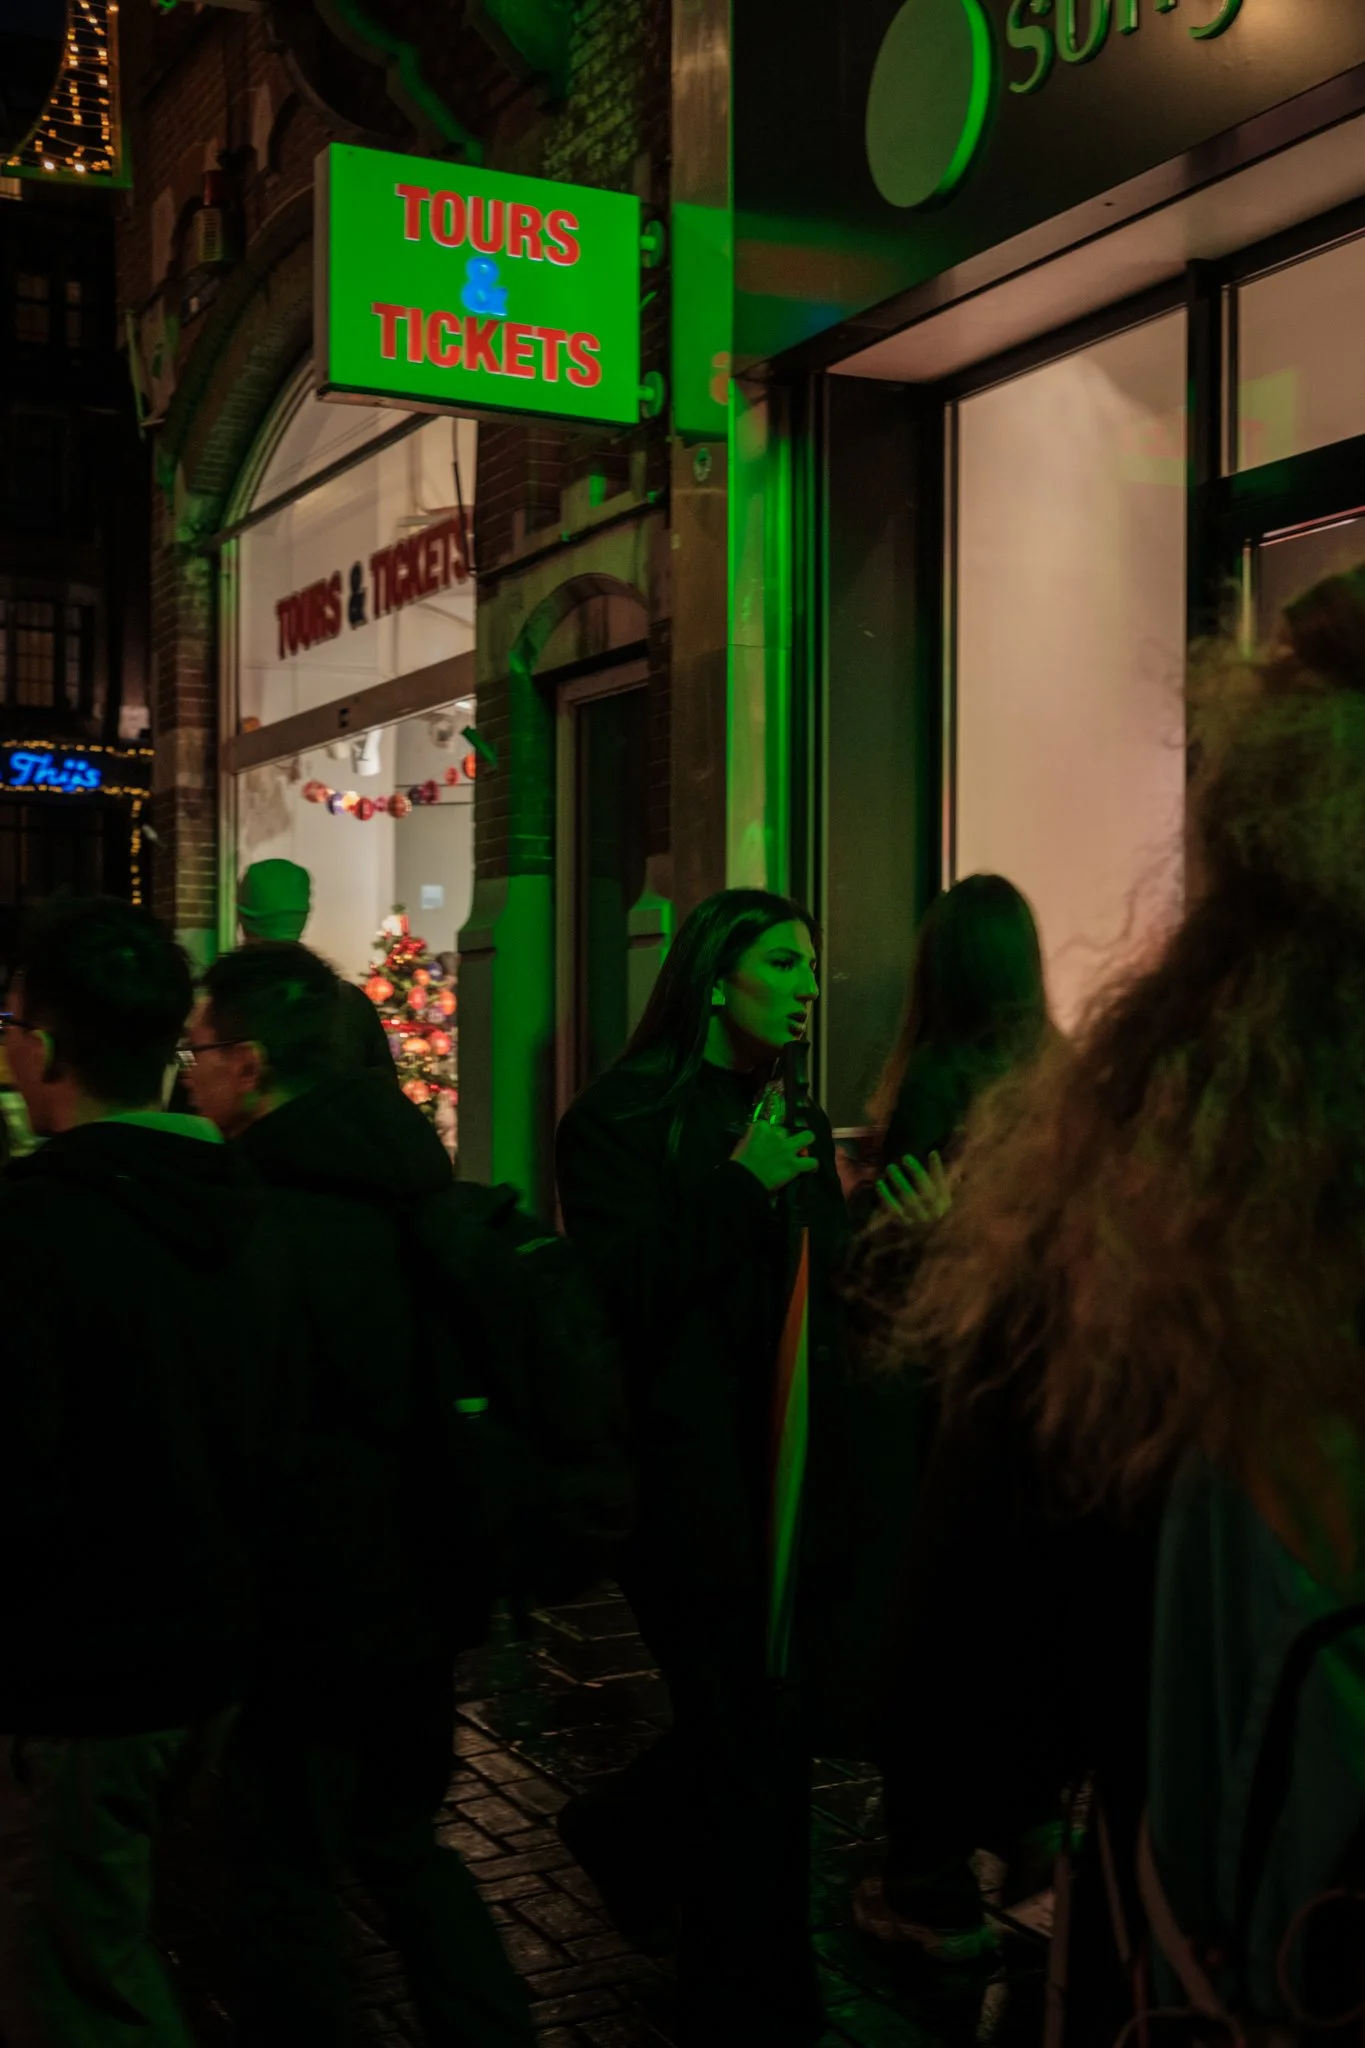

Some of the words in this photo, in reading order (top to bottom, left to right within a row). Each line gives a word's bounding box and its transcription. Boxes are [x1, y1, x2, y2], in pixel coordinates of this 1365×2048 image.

[395, 183, 581, 266] TOURS
[461, 256, 508, 316] &
[371, 302, 602, 388] TICKETS
[275, 570, 343, 661] TOURS
[348, 560, 368, 630] &
[369, 515, 469, 620] TICKETS
